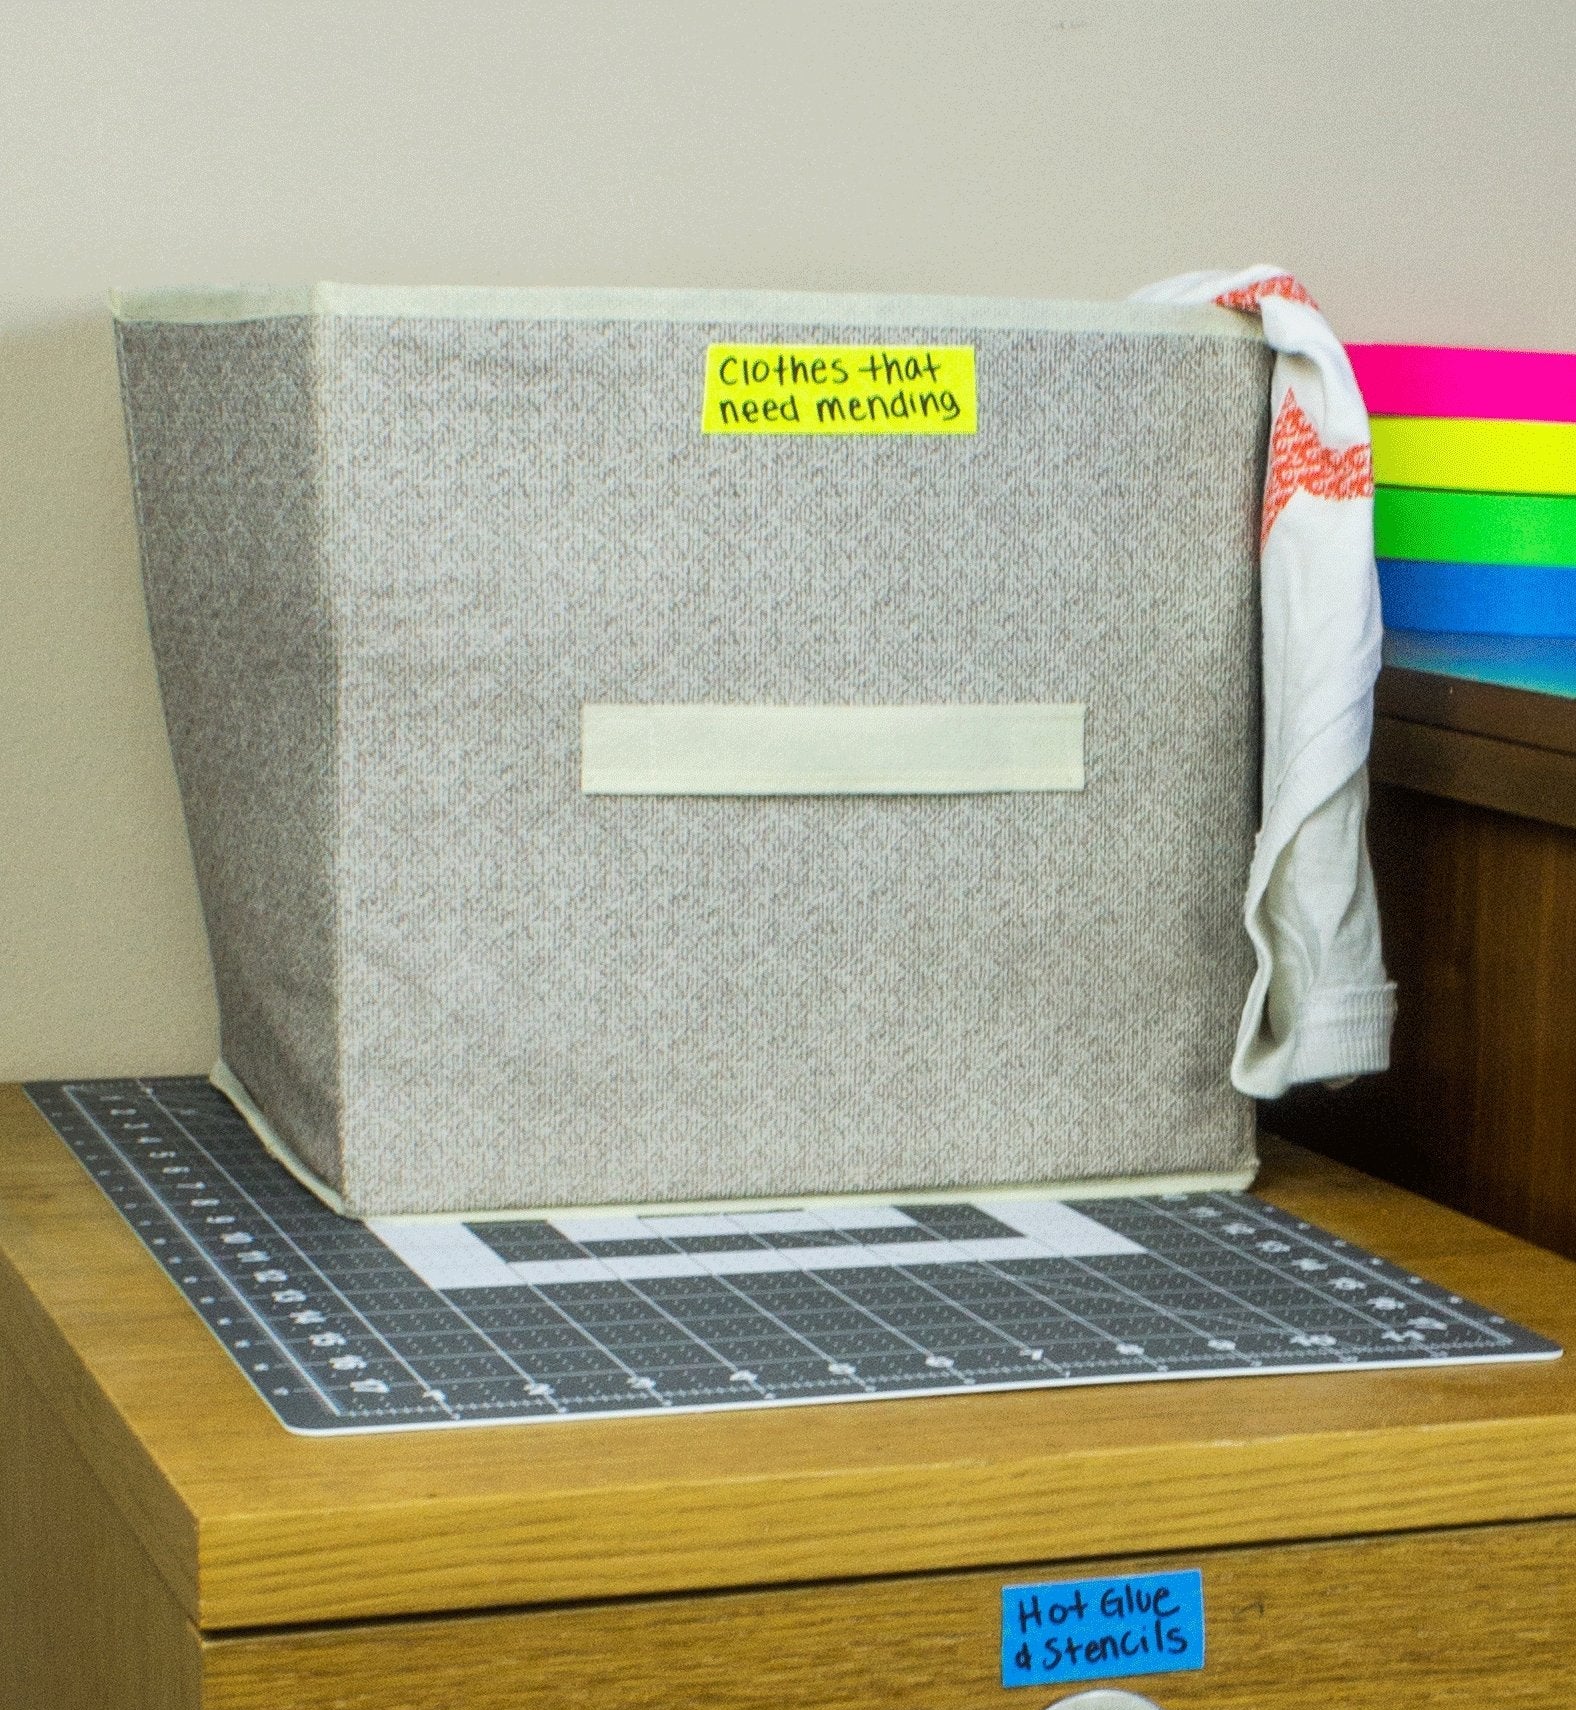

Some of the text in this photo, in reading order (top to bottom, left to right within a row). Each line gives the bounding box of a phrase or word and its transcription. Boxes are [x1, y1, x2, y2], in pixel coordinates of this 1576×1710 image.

[719, 351, 942, 386] Clothes that
[719, 387, 962, 424] need mending
[1018, 1583, 1181, 1634] Hot Glue
[1042, 1618, 1188, 1671] Stencils
